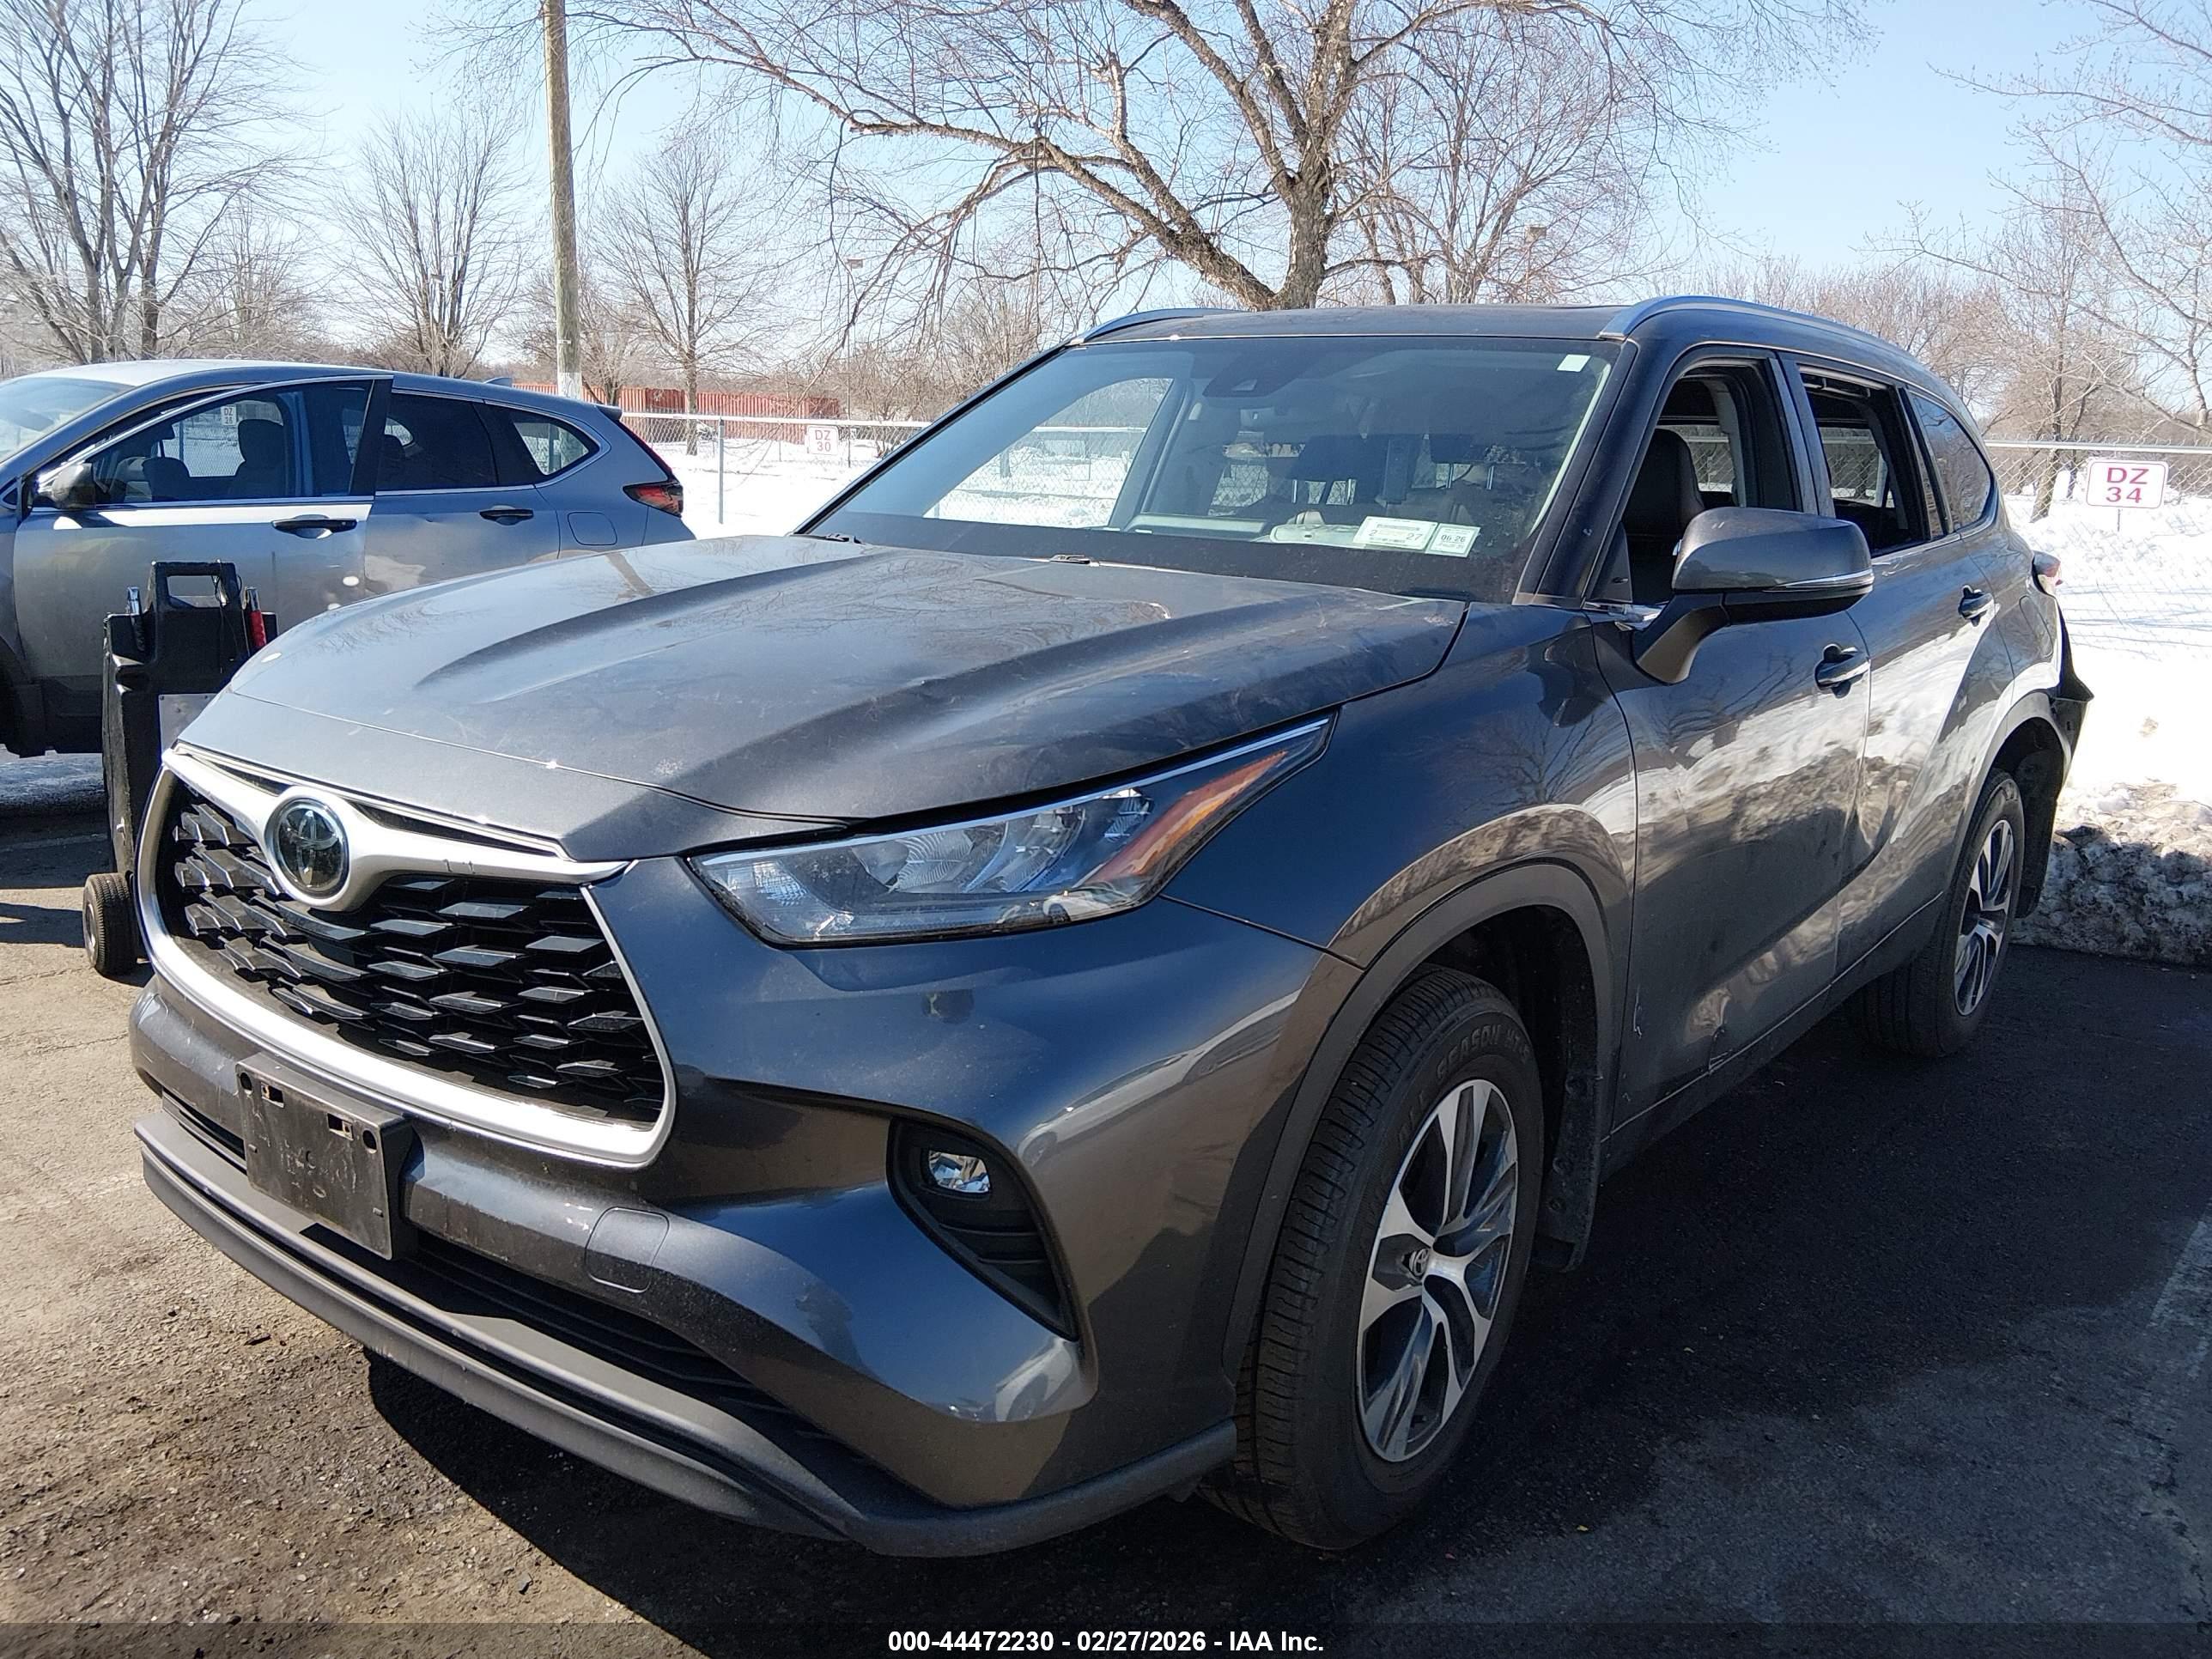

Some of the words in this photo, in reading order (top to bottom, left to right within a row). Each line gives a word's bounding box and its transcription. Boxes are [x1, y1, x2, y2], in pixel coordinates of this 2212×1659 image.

[223, 408, 234, 416] DZ
[815, 429, 831, 441] DZ
[817, 442, 831, 452] 30
[2106, 467, 2149, 485] DZ
[2106, 486, 2142, 504] 34
[1406, 532, 1423, 541] 27
